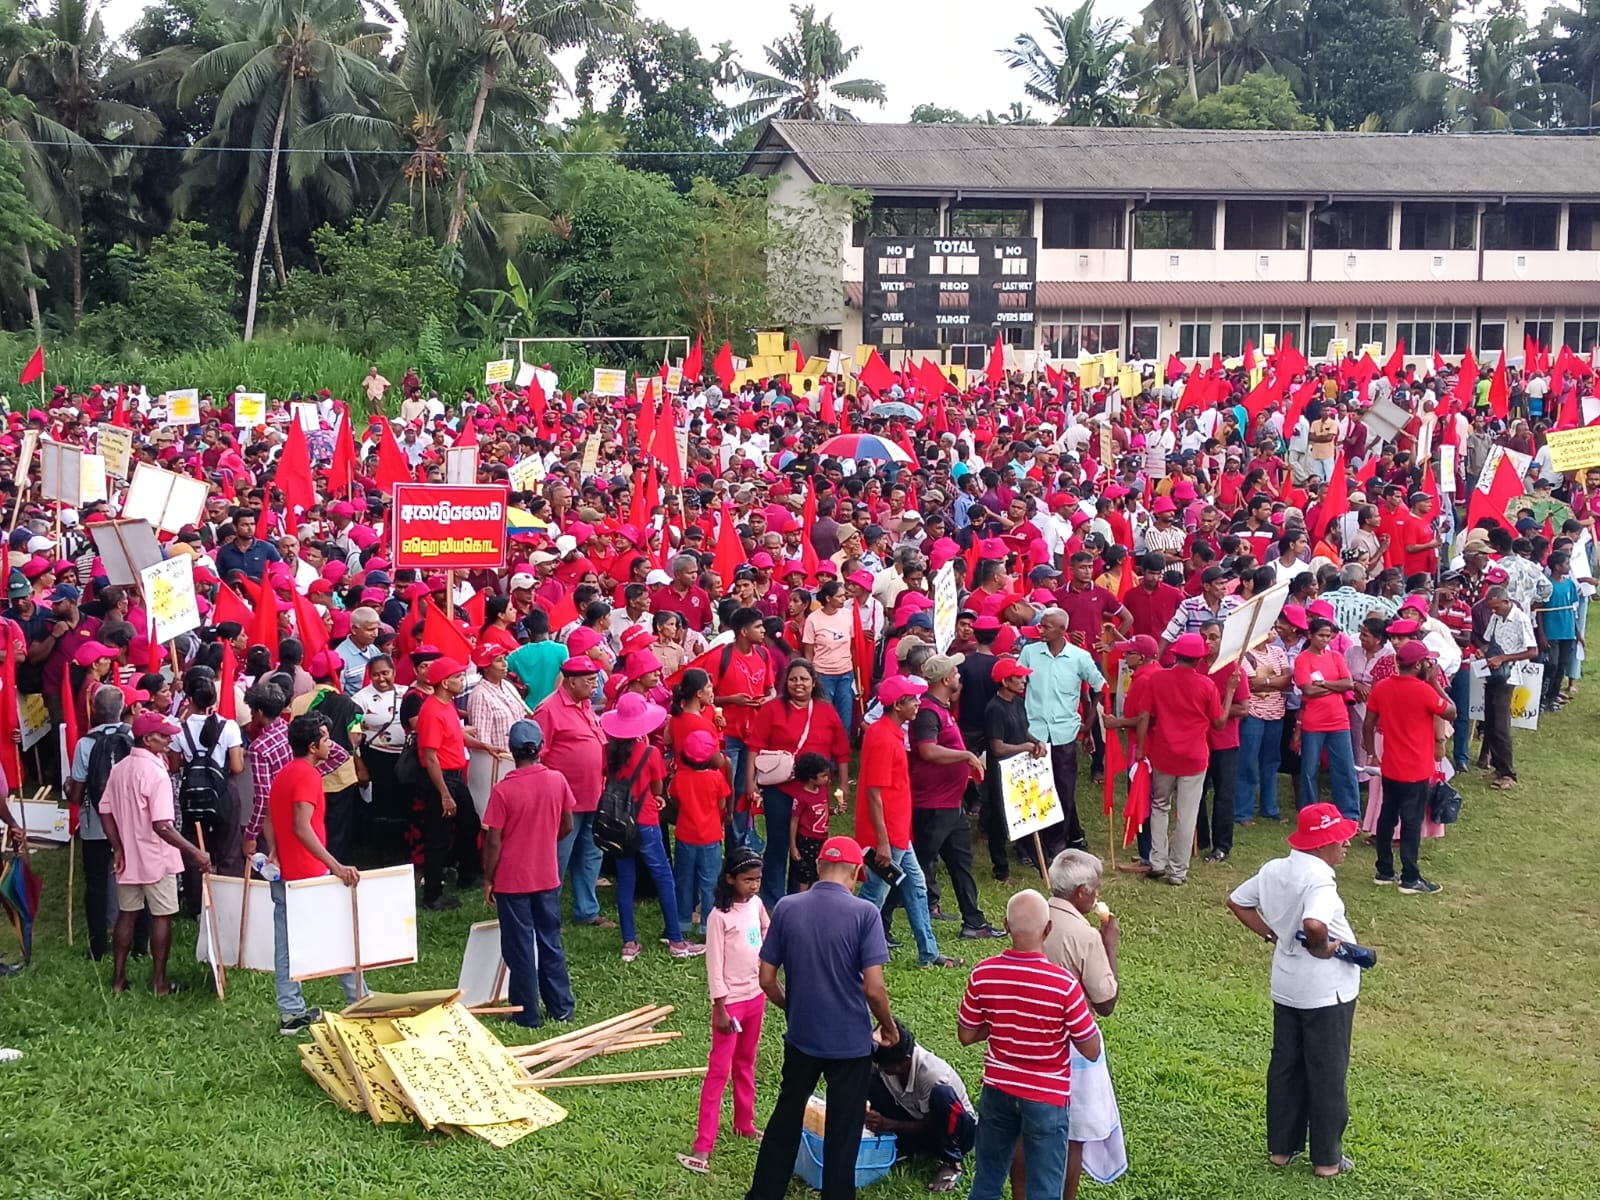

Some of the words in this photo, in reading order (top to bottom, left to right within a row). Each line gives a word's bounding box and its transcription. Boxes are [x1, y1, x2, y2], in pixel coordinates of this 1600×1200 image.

[887, 246, 902, 254] NO
[933, 240, 976, 253] TOTAL
[1006, 246, 1021, 255] NO
[880, 282, 904, 290] WKTS
[940, 282, 969, 290] REQD
[1002, 282, 1017, 290] LAST
[882, 312, 904, 321] OVERS
[935, 315, 970, 324] TARGET
[997, 312, 1018, 321] OVERS
